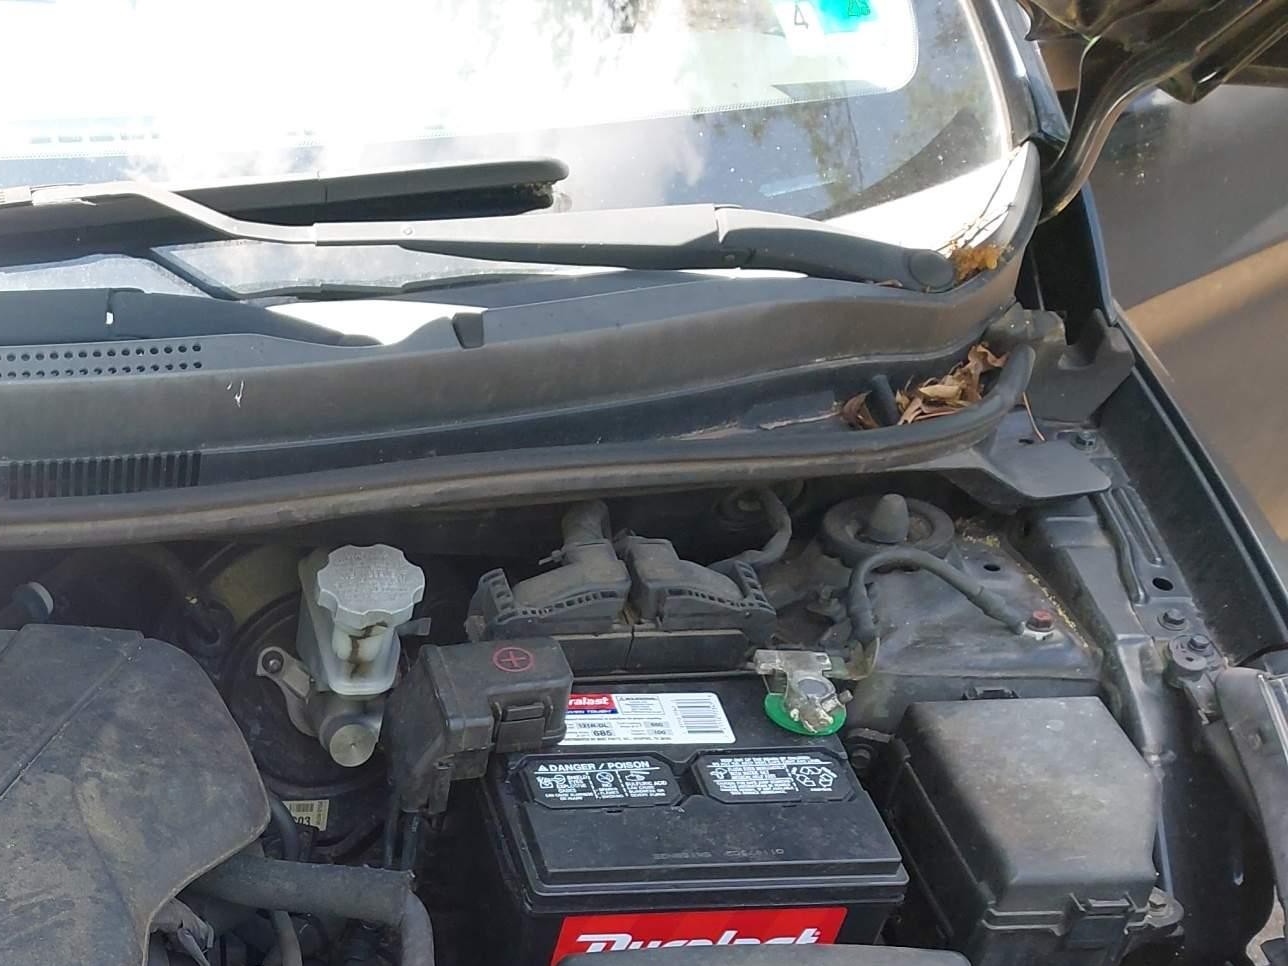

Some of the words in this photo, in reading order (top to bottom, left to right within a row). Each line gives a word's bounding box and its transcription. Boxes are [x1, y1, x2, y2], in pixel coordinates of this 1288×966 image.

[568, 697, 609, 705] ralast
[548, 763, 596, 772] DANGER
[607, 761, 650, 769] POISON
